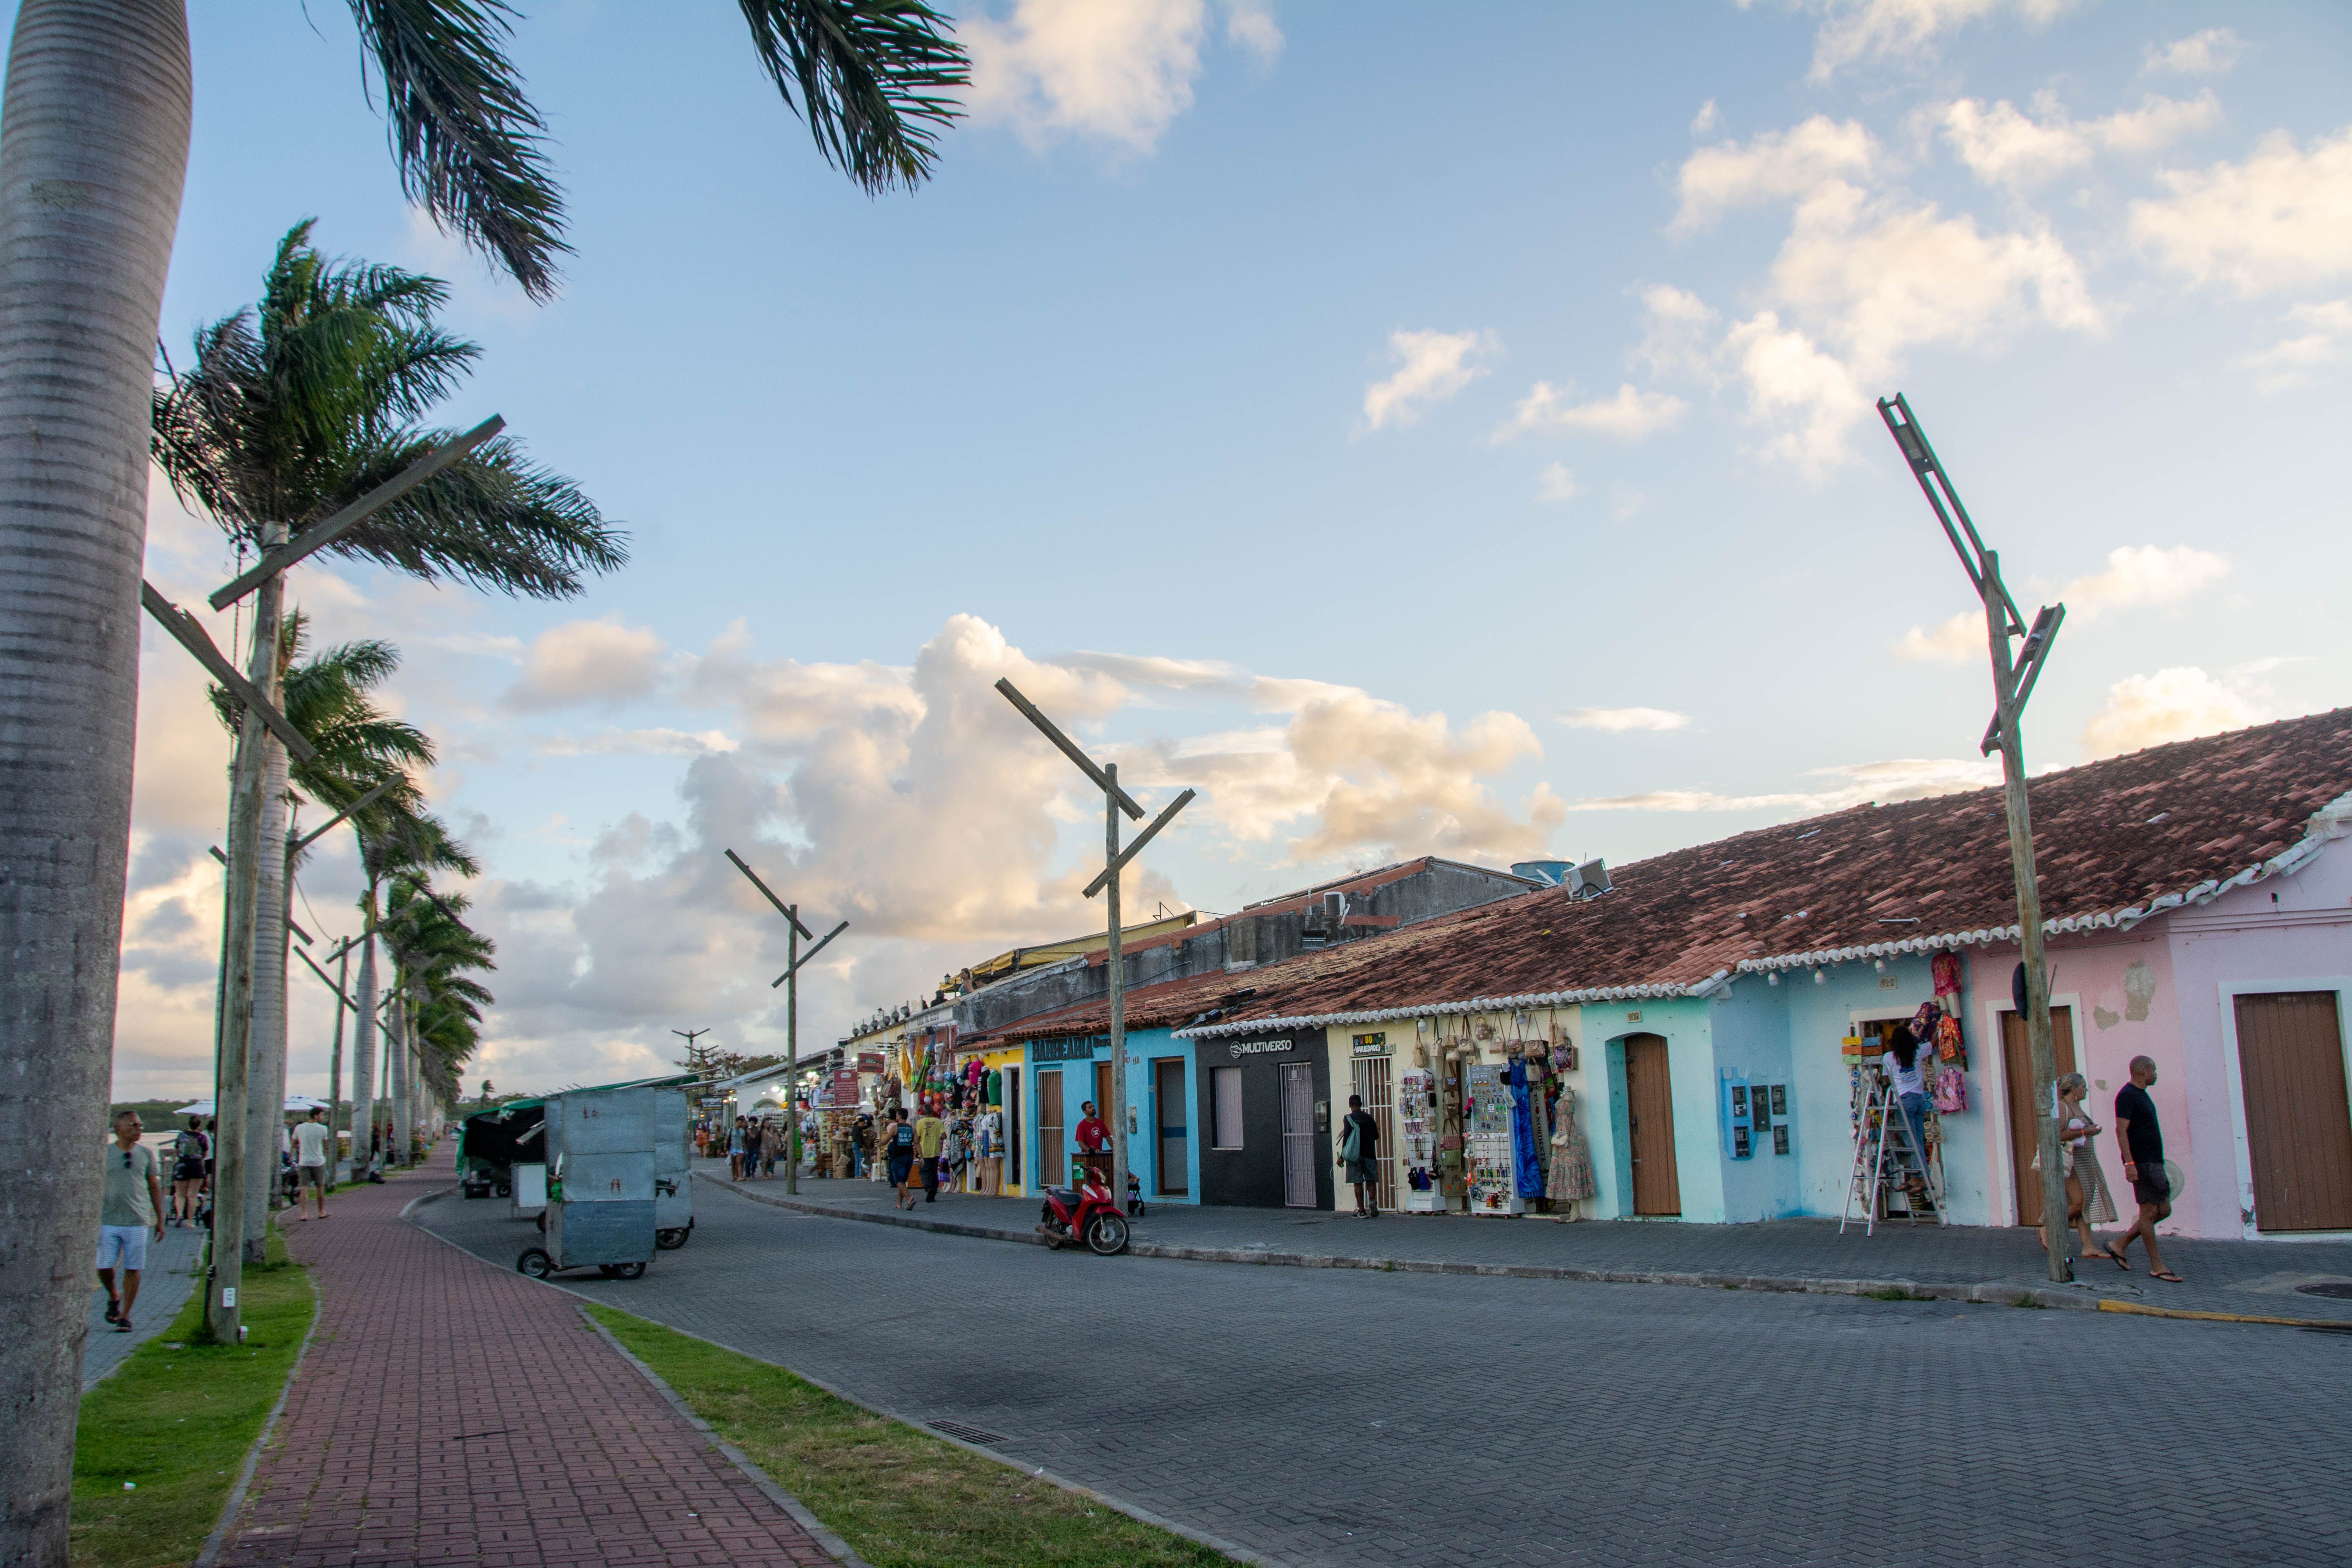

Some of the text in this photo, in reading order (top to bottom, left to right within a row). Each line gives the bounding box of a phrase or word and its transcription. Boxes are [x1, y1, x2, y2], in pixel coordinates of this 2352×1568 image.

[1359, 1035, 1373, 1044] V 88
[1032, 1036, 1094, 1062] BARBEARIA
[1241, 1040, 1292, 1054] MULTIVERSO
[1355, 1044, 1381, 1053] VARIEDADES
[1536, 1117, 1546, 1163] NORDESTE
